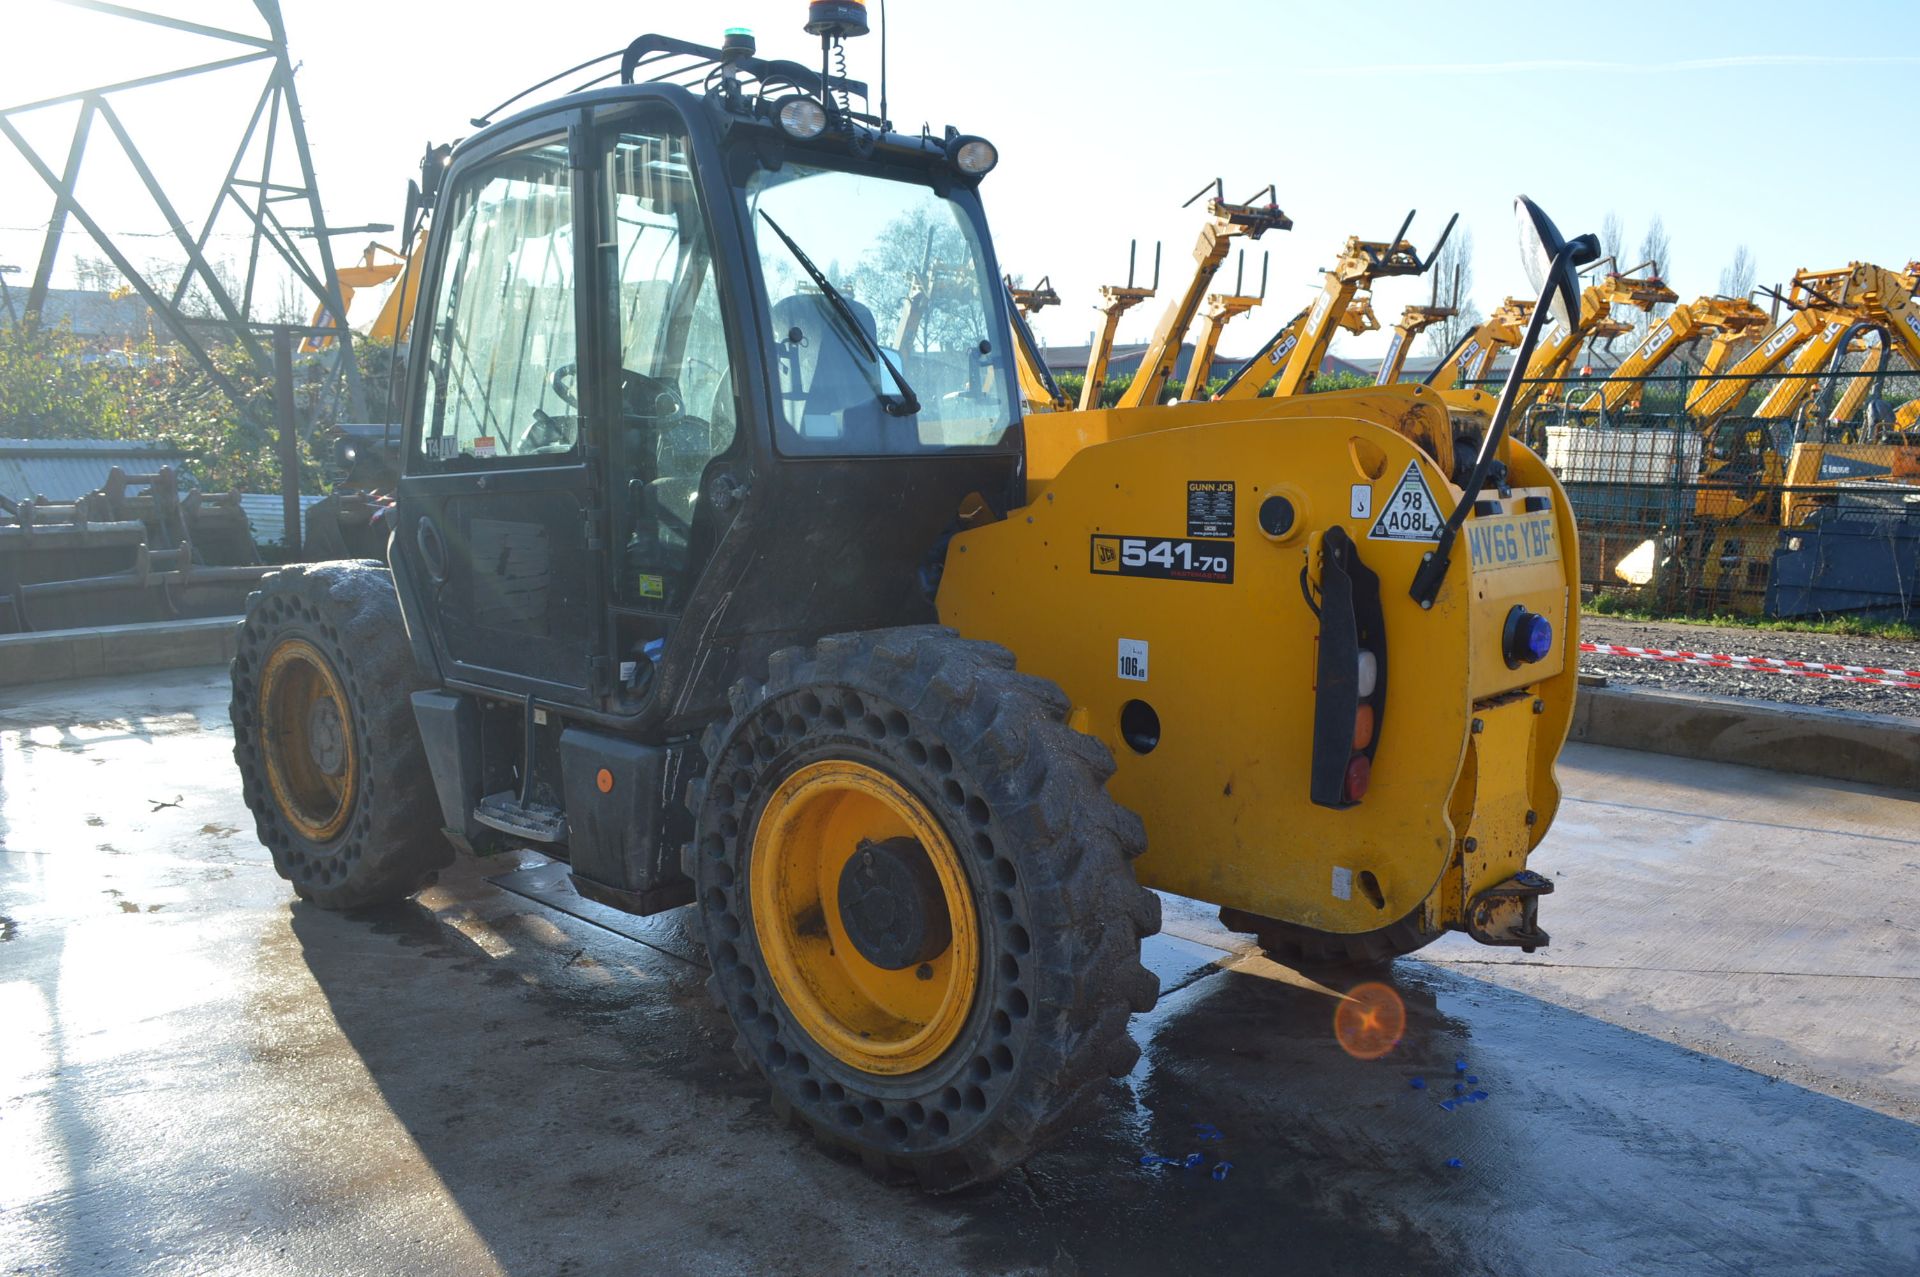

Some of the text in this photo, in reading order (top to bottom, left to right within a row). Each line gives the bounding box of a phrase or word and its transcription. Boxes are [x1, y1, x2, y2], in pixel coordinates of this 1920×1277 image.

[1270, 335, 1297, 365] JCB
[1642, 325, 1674, 360] JCB
[1764, 323, 1798, 357] JCB
[1457, 341, 1480, 367] JCB
[1189, 483, 1234, 492] GUNN JCB
[1402, 491, 1422, 511] 98
[1097, 544, 1117, 564] JCB
[1468, 519, 1551, 566] MV66 YBF
[1120, 655, 1138, 677] 106
